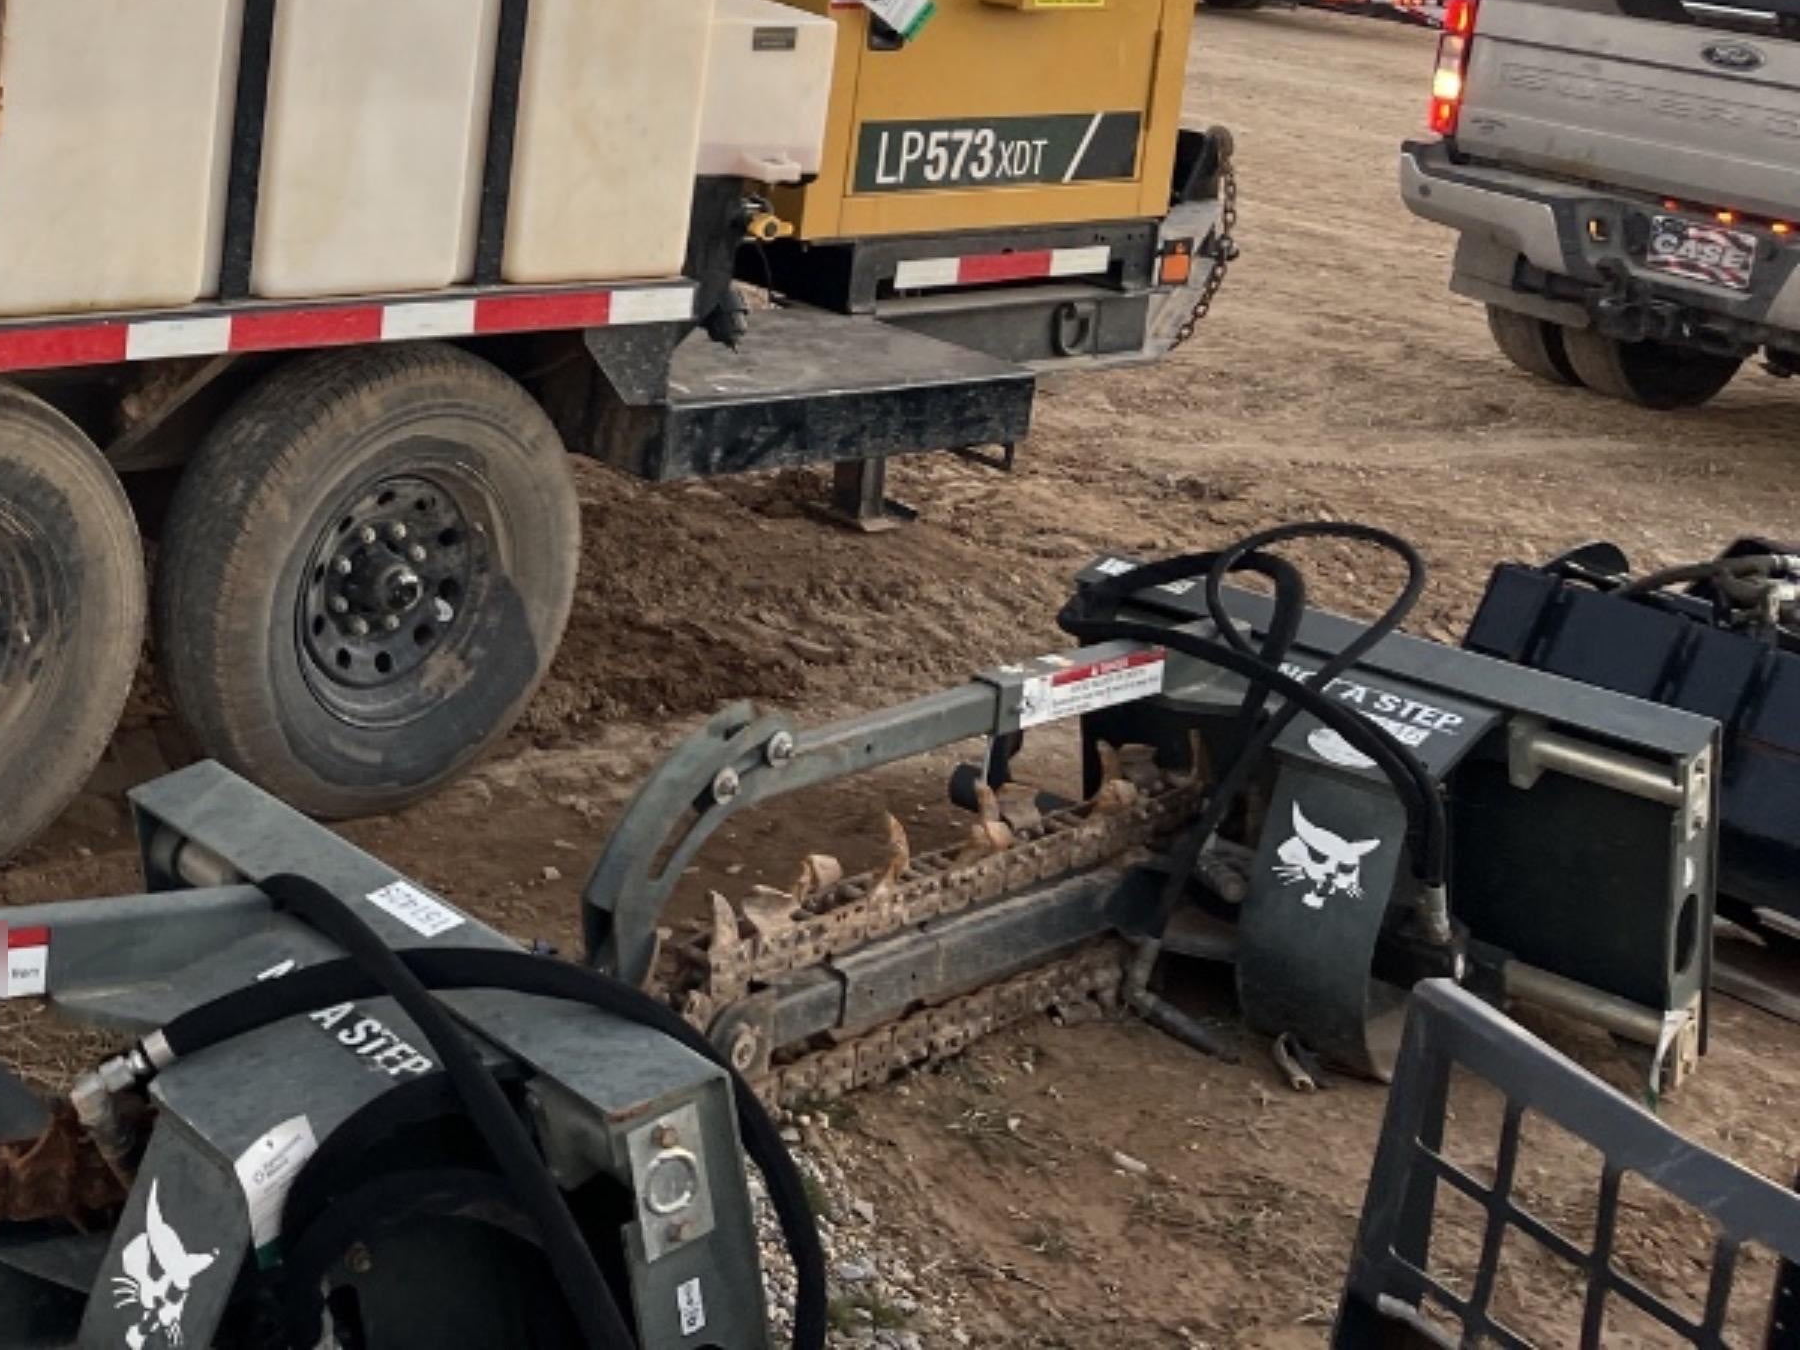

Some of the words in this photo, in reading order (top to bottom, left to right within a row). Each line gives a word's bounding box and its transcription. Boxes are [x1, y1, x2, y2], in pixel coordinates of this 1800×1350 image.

[1654, 233, 1747, 269] CASE
[1373, 693, 1463, 730] STEP
[309, 1001, 355, 1030] A
[337, 1017, 433, 1076] STEP
